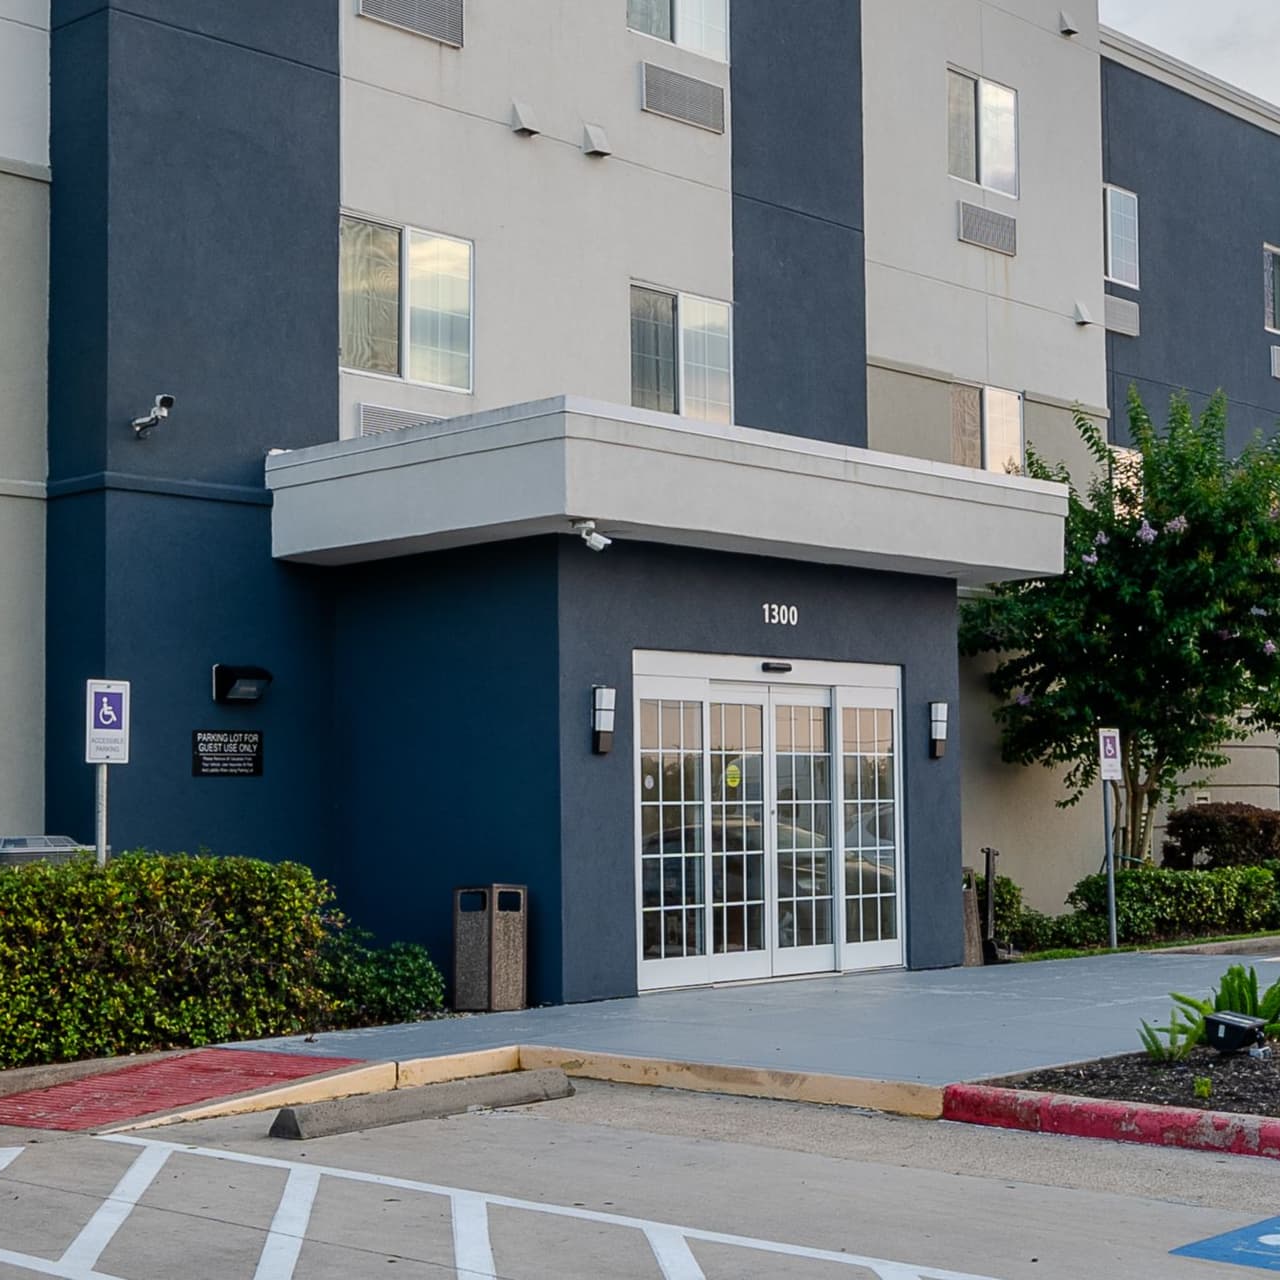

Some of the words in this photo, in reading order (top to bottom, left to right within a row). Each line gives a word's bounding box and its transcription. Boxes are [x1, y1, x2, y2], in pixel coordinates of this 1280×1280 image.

[762, 603, 798, 626] 1300
[197, 733, 228, 742] PARKING
[229, 733, 243, 742] LOT
[243, 733, 259, 742] FOR
[198, 743, 222, 752] GUEST
[223, 743, 238, 752] USE
[238, 743, 258, 752] ONLY
